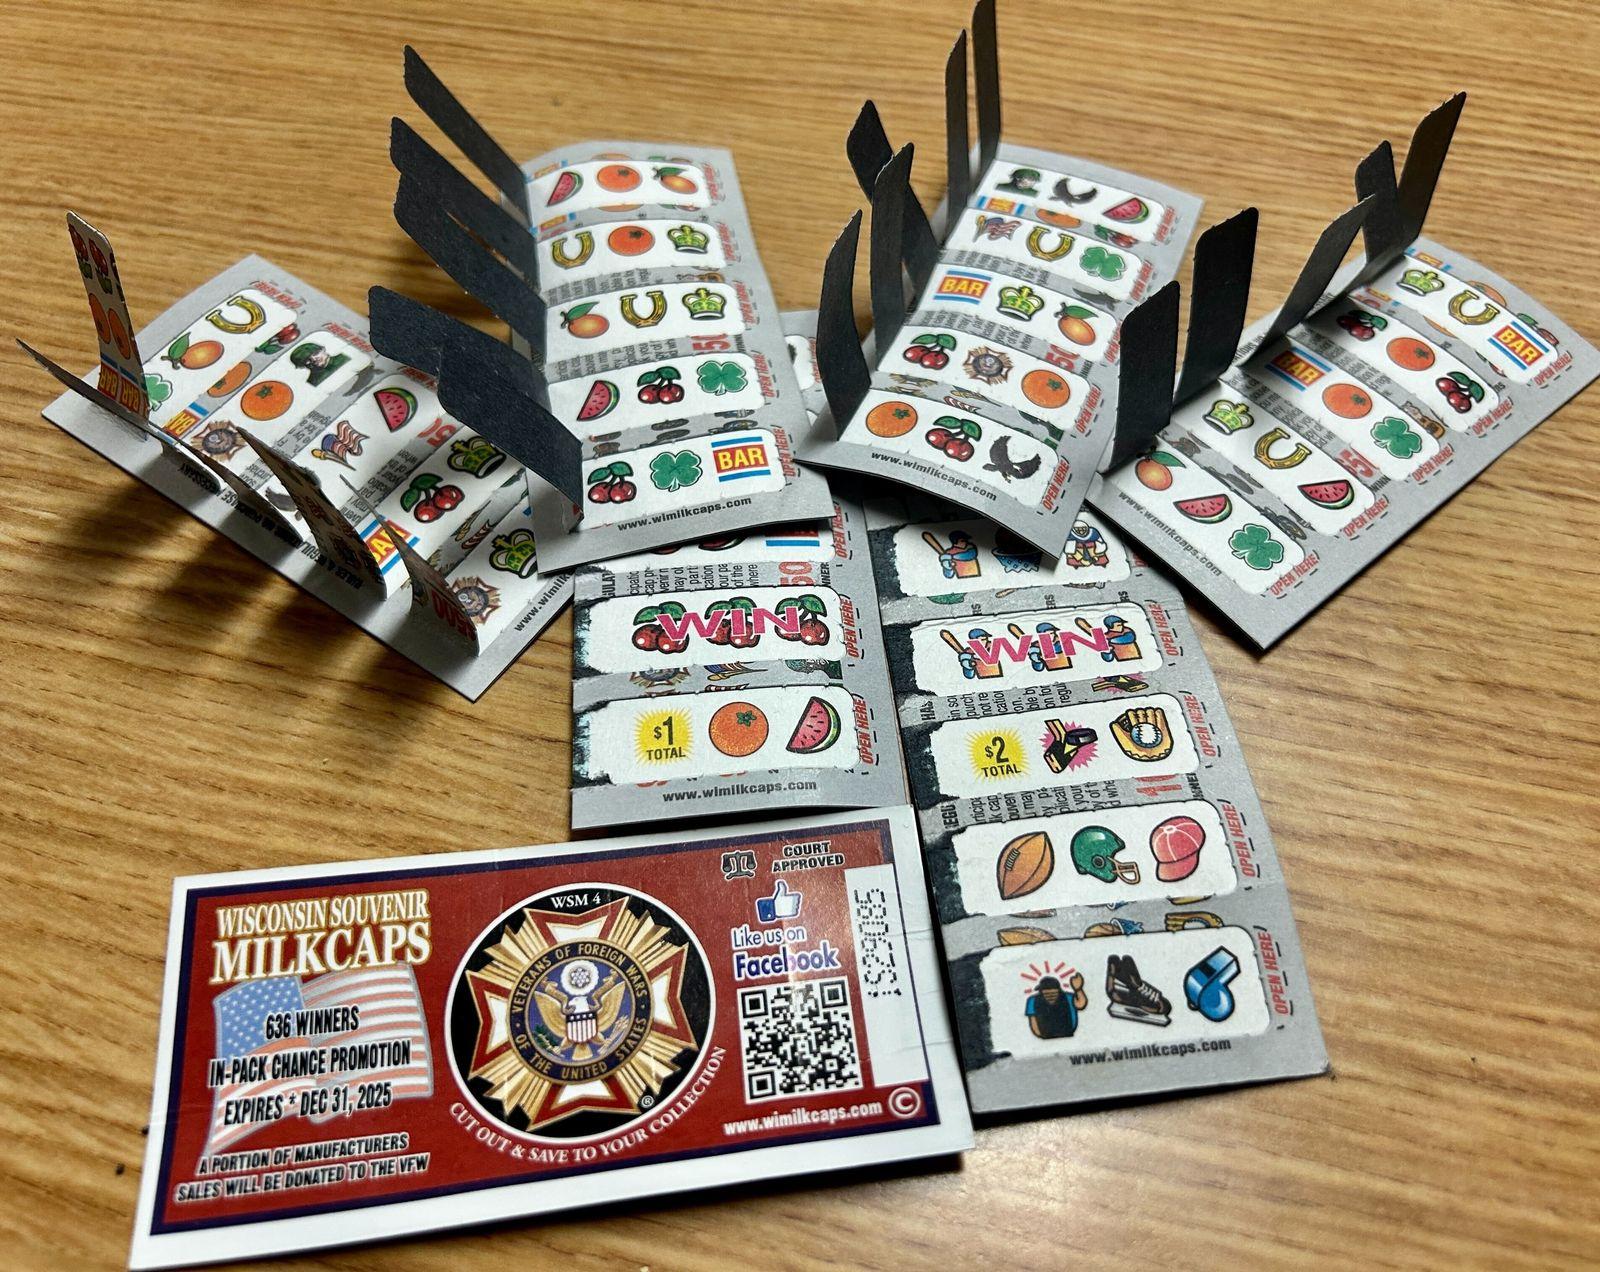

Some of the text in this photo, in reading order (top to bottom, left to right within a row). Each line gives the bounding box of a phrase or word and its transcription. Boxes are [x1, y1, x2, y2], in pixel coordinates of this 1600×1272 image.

[940, 277, 984, 297] BAR
[1500, 325, 1544, 366] BAR
[752, 352, 777, 398] OPEN HERE
[1274, 350, 1321, 386] BAR
[1532, 351, 1573, 385] OPEN HERE
[1076, 409, 1092, 435] OPEN
[1084, 385, 1102, 412] HERE
[718, 449, 766, 472] BAR
[771, 426, 797, 477] OPEN HERE
[1411, 444, 1454, 482] OPEN HERE
[871, 450, 998, 502] www.wimilkcaps.com
[1042, 460, 1070, 512] OPEN HERE
[616, 498, 753, 532] www.wimilkcaps.com
[1344, 496, 1390, 538] OPEN HERE
[834, 529, 848, 559] OPEN
[1118, 491, 1222, 578] www.wimilkcaps.com
[1270, 553, 1320, 597] OPEN HERE
[656, 606, 800, 642] WIN
[840, 598, 860, 659] OPEN HERE
[1148, 602, 1179, 657] OPEN HERE
[967, 628, 1112, 666] WIN
[1183, 693, 1203, 725] HERE
[653, 716, 674, 746] $1
[853, 697, 874, 764] OPEN HERE
[985, 736, 1010, 763] $2
[1193, 726, 1217, 758] OPEN
[646, 747, 686, 762] TOTAL
[981, 764, 1022, 778] TOTAL
[663, 780, 817, 802] www.wimilkcaps.com
[784, 842, 831, 857] COURT
[1222, 803, 1258, 878] OPEN HERE
[772, 854, 845, 874] APPROVED
[217, 889, 430, 939] WISCONSIN SOUVENIR
[551, 893, 602, 909] WSM 4
[209, 920, 432, 985] MILKCAPS
[734, 926, 806, 948] Like us on
[512, 943, 648, 1014] VETERANS OF FOREIGN WARS
[736, 942, 840, 979] Facebook
[1256, 930, 1291, 1016] OPEN HERE
[266, 1006, 360, 1040] 636 WINNERS
[210, 1040, 412, 1087] IN-PACK CHANCE PROMOTION
[515, 1017, 648, 1080] OF THE UNITED STATES
[1069, 1038, 1233, 1065] www.wimilkcaps.com
[225, 1094, 284, 1126] EXPIRES
[300, 1087, 329, 1117] DEC
[332, 1086, 354, 1117] 31,
[357, 1082, 392, 1110] 2025
[450, 1046, 728, 1163] CUT OUT & SAVE TO YOUR COLLECTION
[723, 1101, 884, 1136] www.wimilkcaps.com
[199, 1133, 409, 1174] A PORTION OF MANUFACTURERS
[177, 1153, 430, 1202] SALES WILL BE DONATED TO THE VFW
